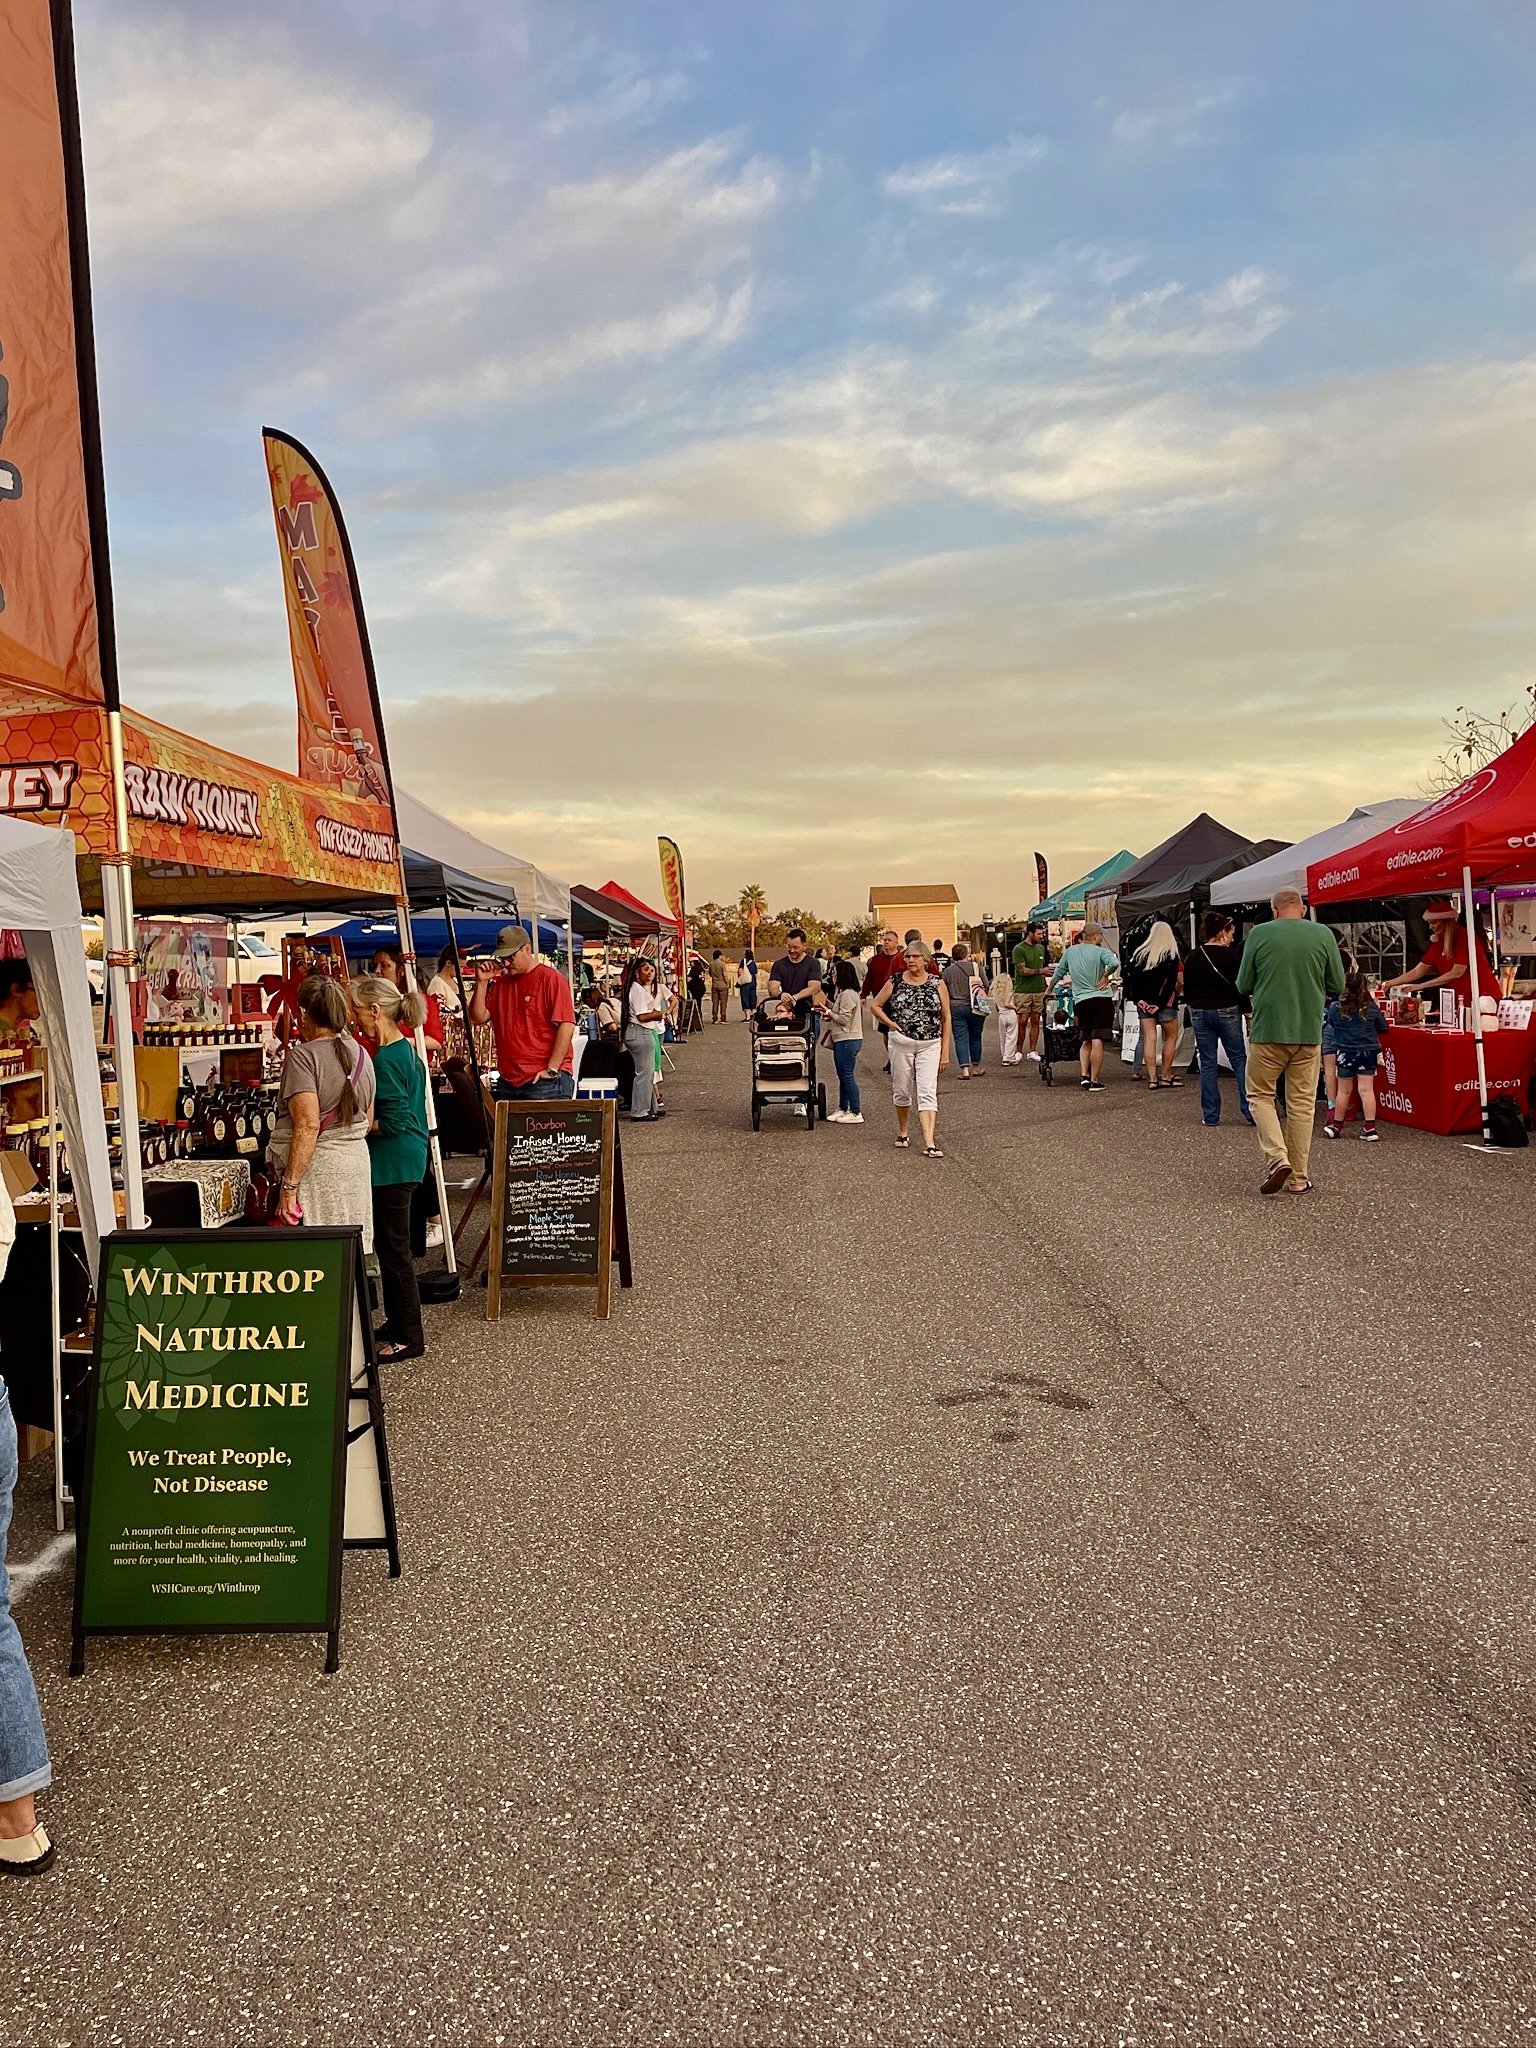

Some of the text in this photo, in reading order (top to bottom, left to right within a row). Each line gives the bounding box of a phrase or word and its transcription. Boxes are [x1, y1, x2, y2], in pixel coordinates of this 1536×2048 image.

[124, 761, 262, 838] RAW HONEY
[316, 816, 395, 863] INFUSED HONEY
[1386, 846, 1443, 870] edible.com
[1317, 866, 1360, 890] edible.com
[148, 970, 171, 990] BEIN
[1454, 1079, 1521, 1092] edibe.com
[1380, 1090, 1413, 1114] edible
[525, 1116, 567, 1132] Bourbon
[513, 1134, 553, 1148] Infused
[557, 1132, 586, 1146] Honey
[536, 1170, 580, 1181] Raw Honey
[529, 1211, 575, 1224] Maple Syrup
[122, 1266, 325, 1297] WINTHROP
[134, 1322, 306, 1353] NATURAL
[123, 1379, 309, 1410] MEDICINE
[127, 1446, 292, 1469] We Treat People,
[153, 1475, 269, 1494] Not Disease
[121, 1524, 296, 1538] A nonprofit clinic offering acupuncture,
[109, 1537, 307, 1551] nutrition, herbal medicine, homeopathy, and
[113, 1551, 299, 1567] more for your health, vitality, and healing.
[151, 1581, 261, 1595] WSHCare.org/Winthrop
